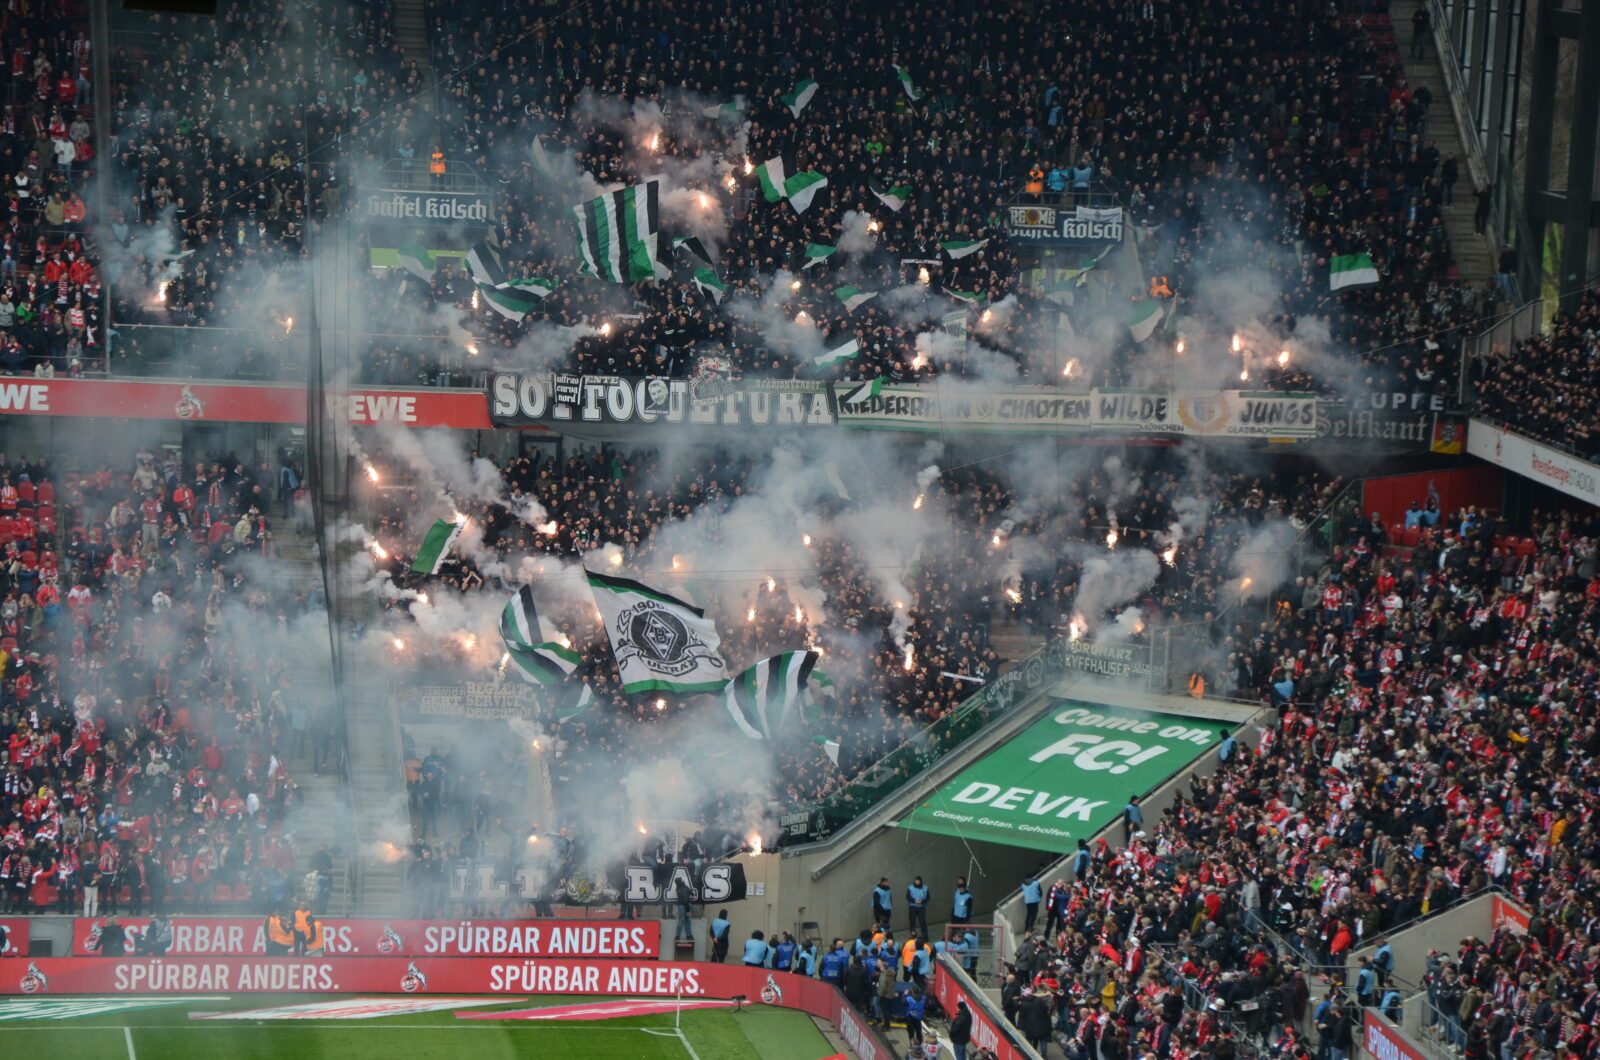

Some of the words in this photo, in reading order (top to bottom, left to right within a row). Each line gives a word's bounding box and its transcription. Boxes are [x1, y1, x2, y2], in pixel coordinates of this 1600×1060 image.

[367, 193, 422, 219] Gaffel
[425, 198, 487, 223] Kölsch
[838, 394, 971, 418] NIEDERRHN
[998, 397, 1091, 419] CHAOTEN
[1101, 395, 1168, 422] WILDE
[1240, 401, 1313, 425] JUNGS
[1316, 407, 1428, 442] Selfkant
[466, 695, 522, 708] SERVICE
[1054, 708, 1160, 734] Come
[1029, 733, 1169, 775] FC!
[952, 781, 1109, 822] DEVK
[932, 810, 974, 825] Gesagt.
[978, 817, 1013, 830] Getan.
[1018, 823, 1072, 838] Geholfen.
[124, 922, 245, 954] SRBAR
[252, 926, 358, 953] ARS.
[424, 921, 540, 954] SPÜRBAR
[548, 927, 652, 955] ANDERS.
[115, 959, 230, 990] SPÜRBAR
[237, 964, 339, 990] ANDERS.
[490, 960, 600, 992] SPÜRBAR
[607, 966, 705, 994] ANDERS.
